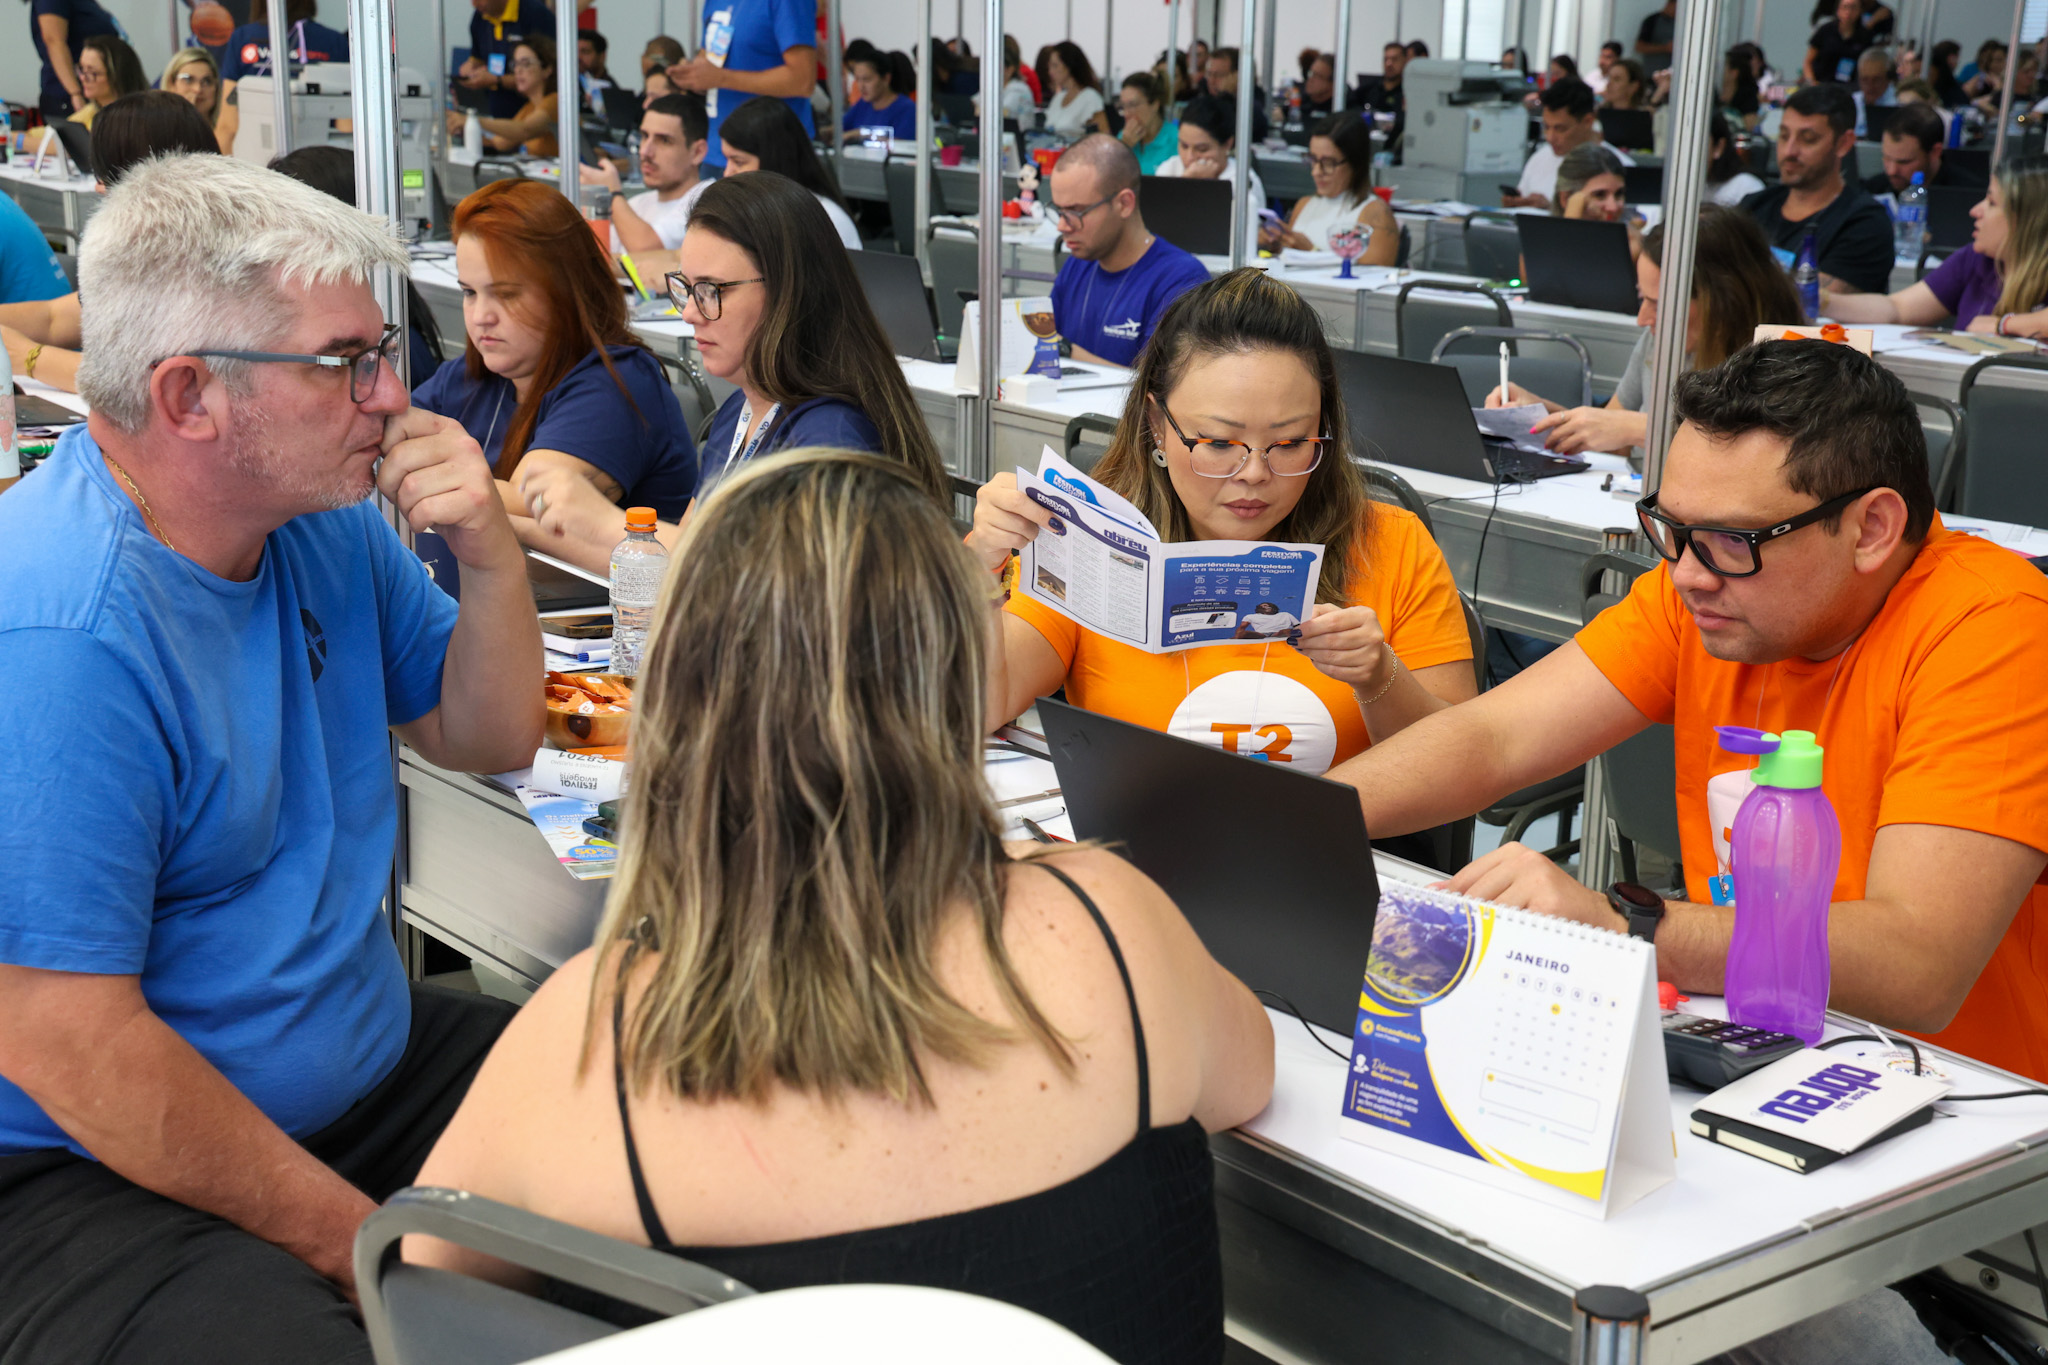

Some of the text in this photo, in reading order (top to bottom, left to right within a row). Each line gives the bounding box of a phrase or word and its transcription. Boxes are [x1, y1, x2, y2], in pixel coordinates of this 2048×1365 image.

[1104, 529, 1148, 553] abreu
[1174, 632, 1194, 640] Azul
[1211, 722, 1293, 762] T2
[560, 780, 597, 791] FESTIVAL
[1505, 950, 1570, 974] JANEIRO
[1758, 1063, 1882, 1124] abreu
